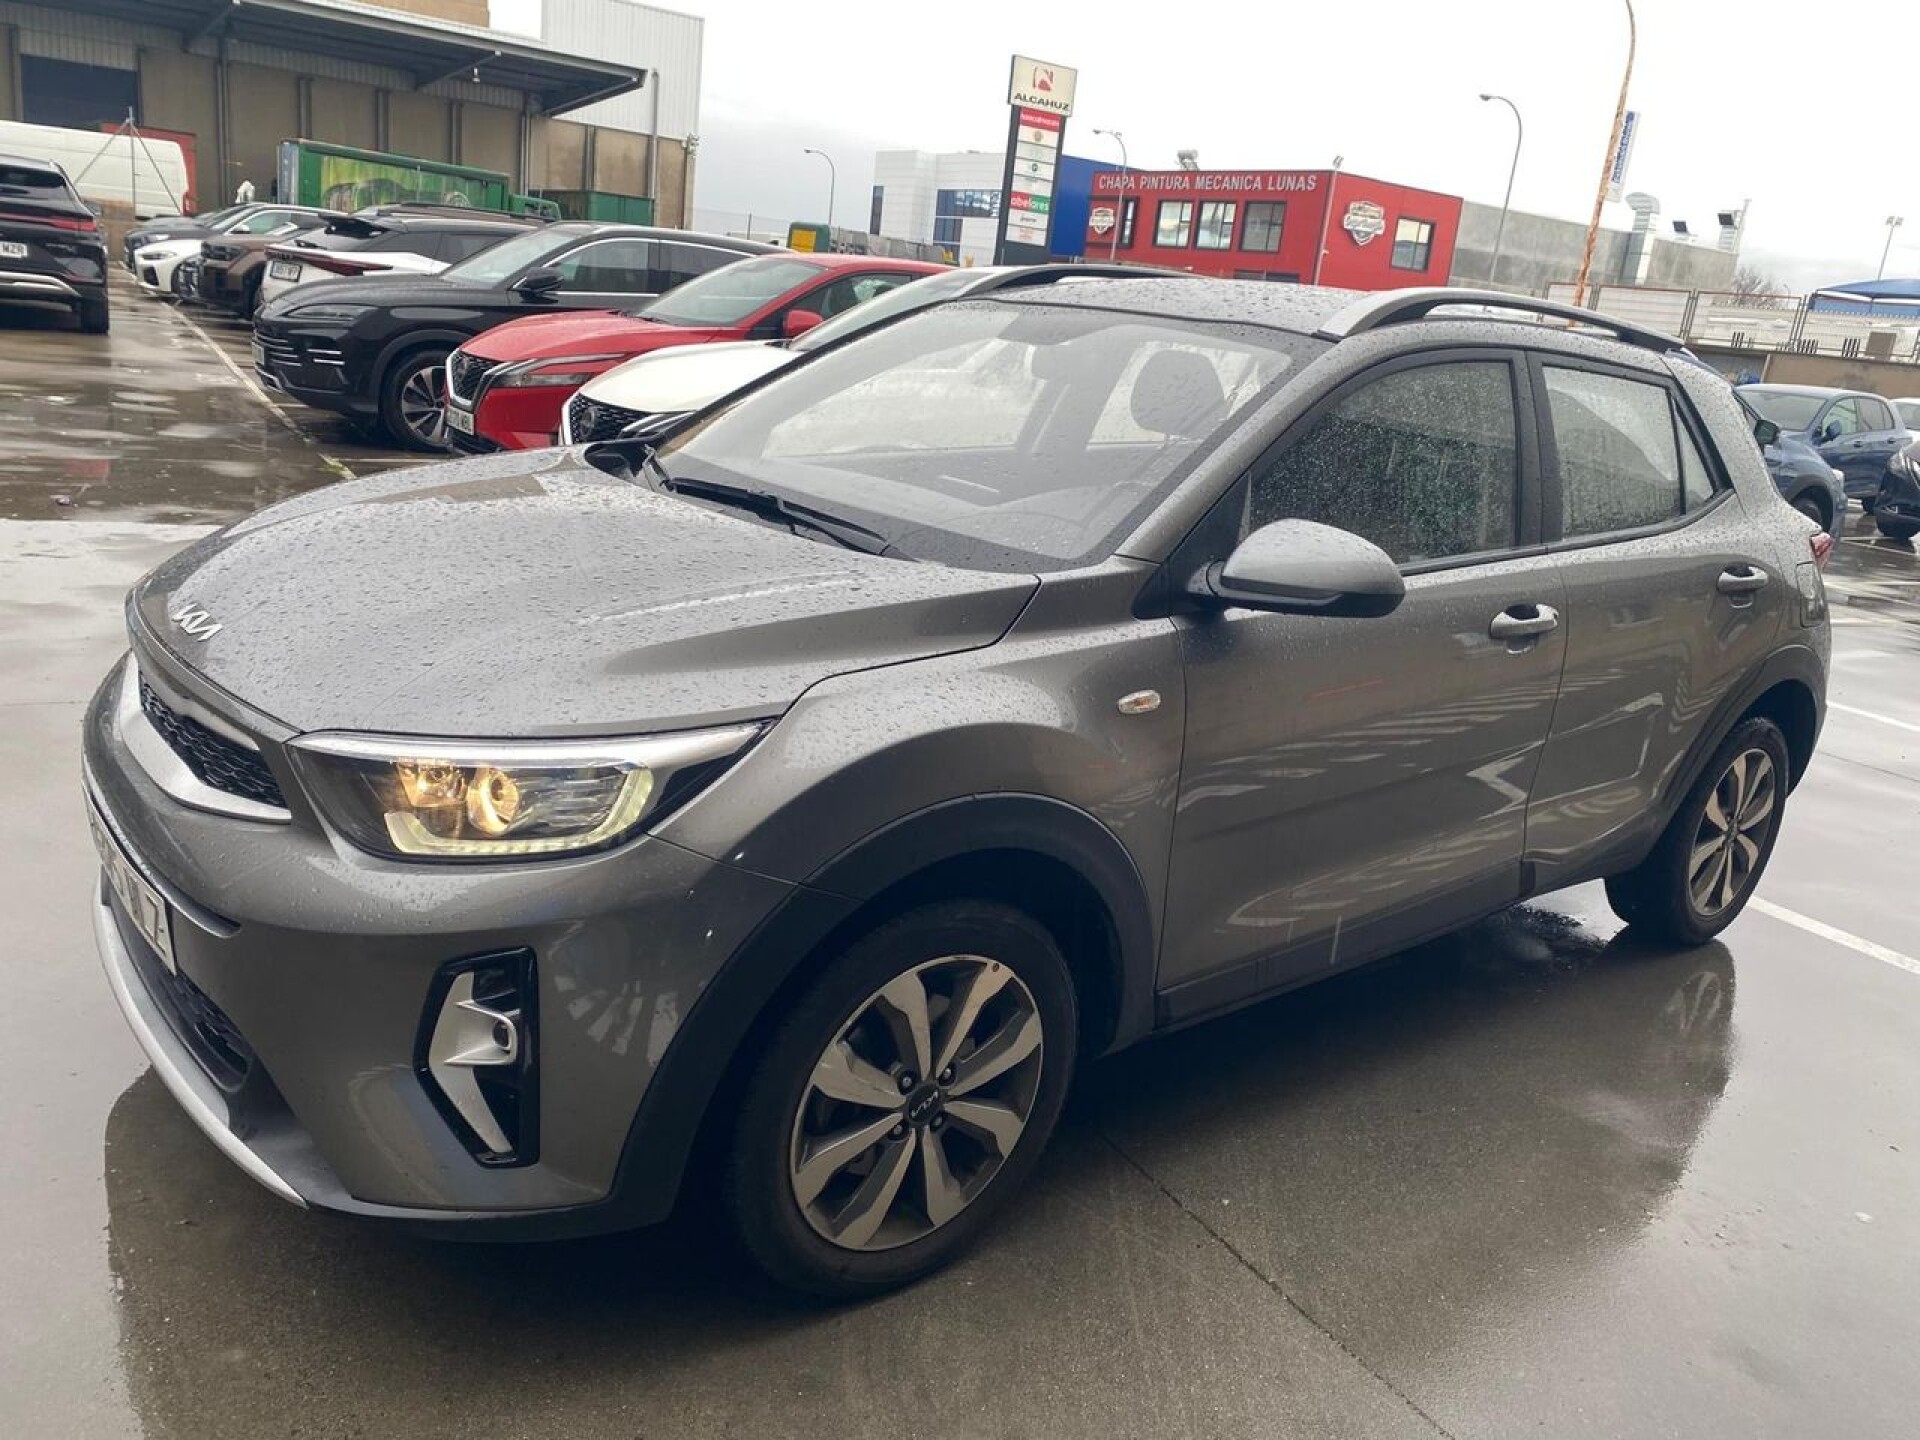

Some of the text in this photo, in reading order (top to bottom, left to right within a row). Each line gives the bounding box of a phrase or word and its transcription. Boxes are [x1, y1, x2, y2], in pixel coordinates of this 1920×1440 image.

[1014, 92, 1069, 110] ALCAHUZ
[1099, 175, 1317, 191] CHAPA PINTURA MECANICA LUNAS
